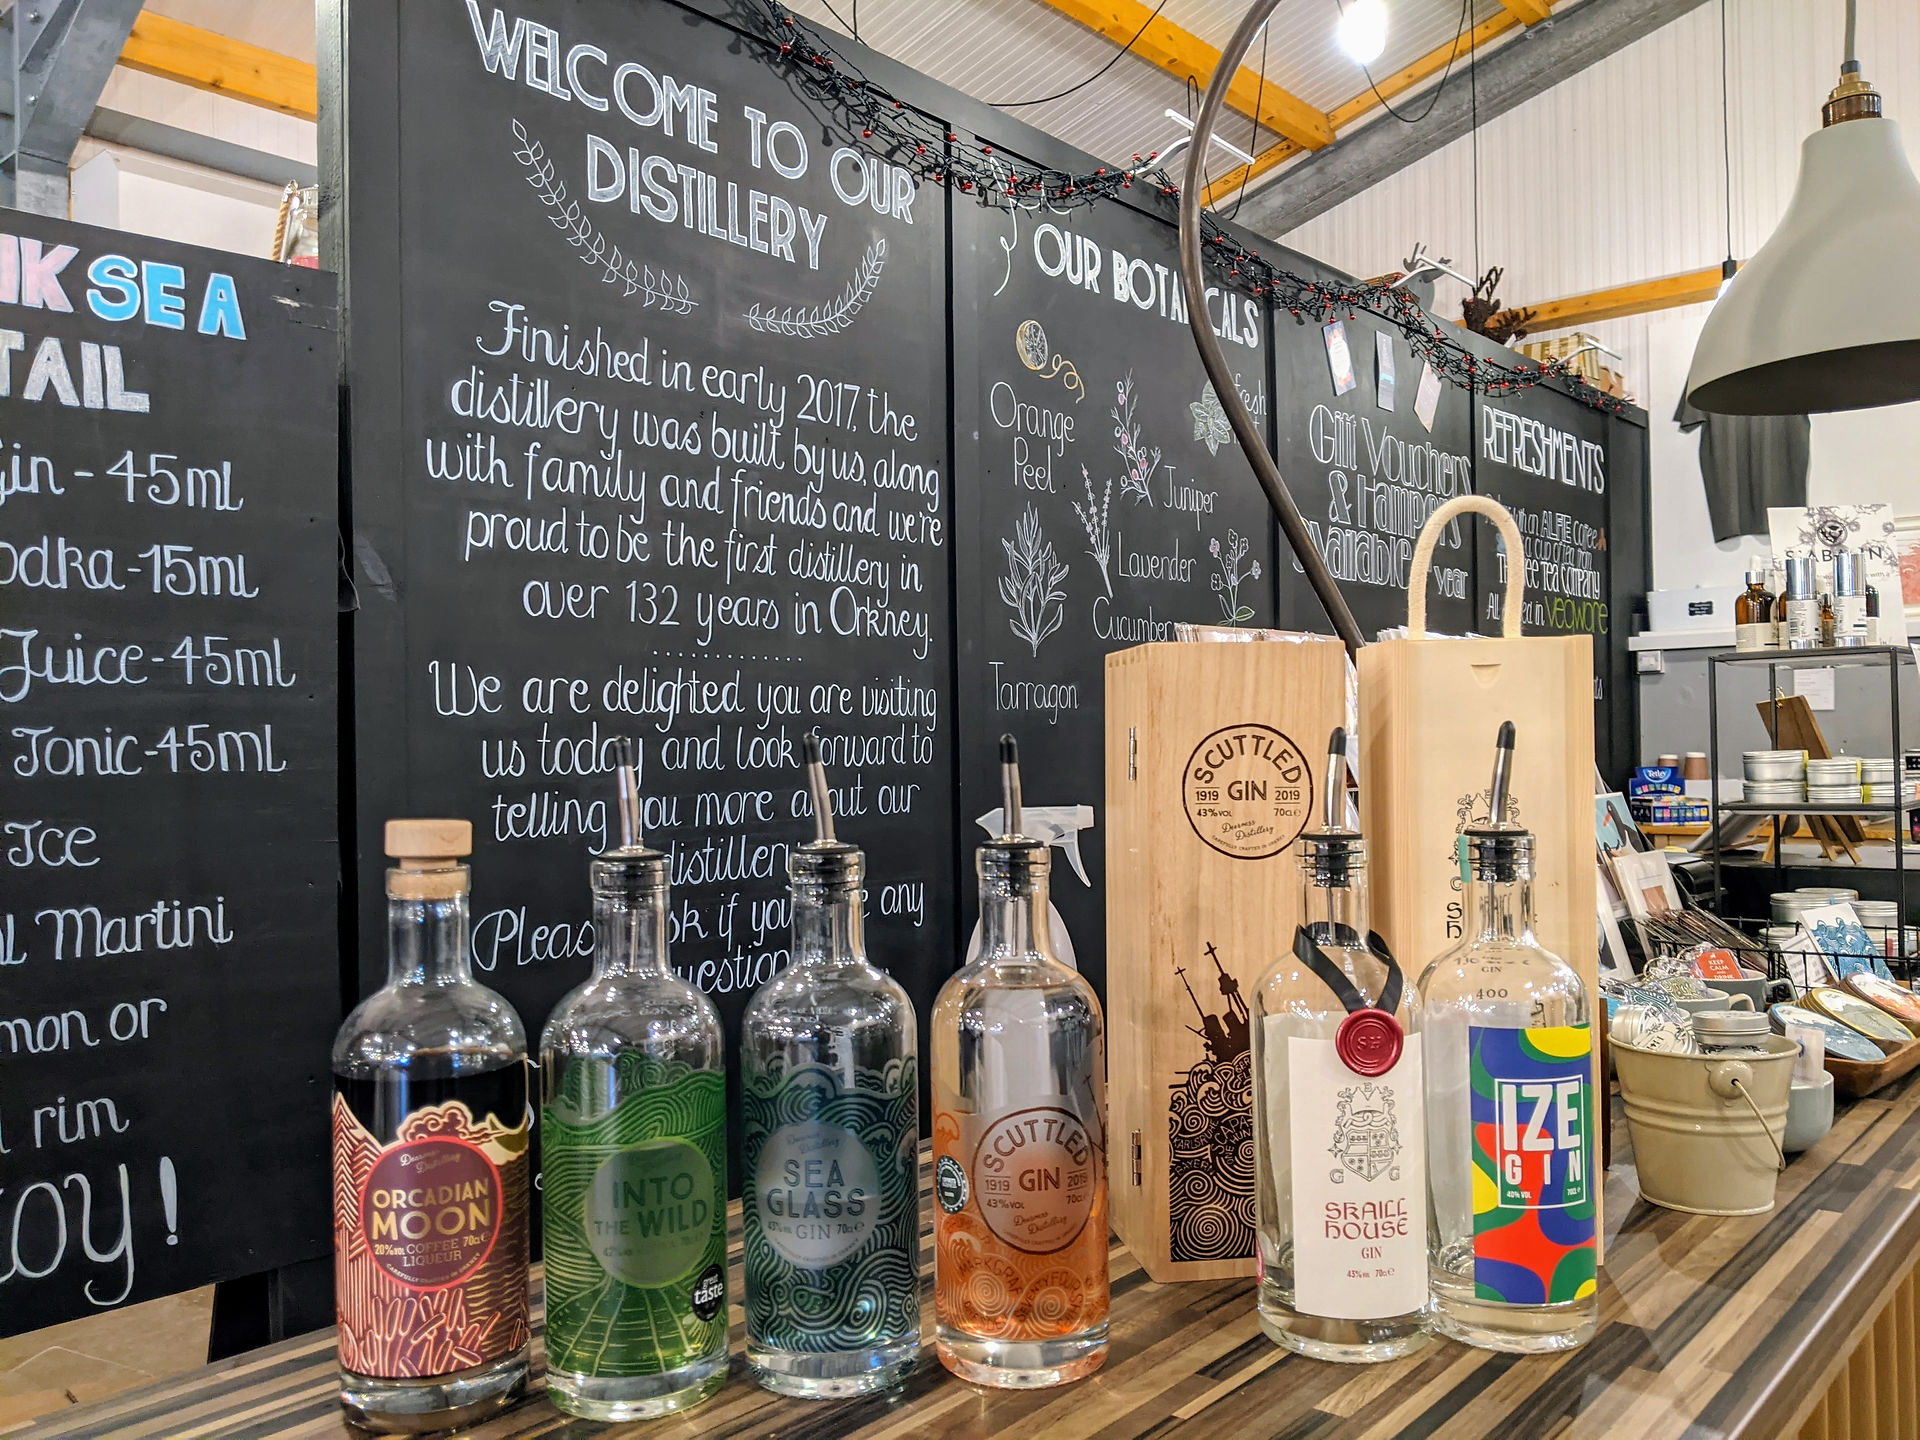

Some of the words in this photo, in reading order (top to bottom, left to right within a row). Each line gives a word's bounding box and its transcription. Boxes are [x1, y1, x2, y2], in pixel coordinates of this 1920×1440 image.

[466, 0, 718, 153] WELCOME
[744, 106, 808, 179] TO
[830, 148, 915, 224] OUR
[587, 134, 828, 270] DISTILLERY
[1034, 223, 1102, 294] OUR
[86, 254, 246, 340] SEA
[476, 300, 652, 386] Finished
[662, 349, 695, 393] in
[702, 366, 786, 429] early
[867, 388, 918, 441] the
[451, 365, 618, 460] distillery
[633, 410, 701, 455] was
[711, 411, 785, 469] built
[793, 427, 826, 493] by
[832, 449, 867, 486] us,
[873, 449, 939, 513] along
[991, 381, 1075, 457] Orange
[1014, 436, 1056, 494] Peel
[1310, 404, 1358, 471] Gift
[1361, 417, 1472, 496] Vouchers
[1483, 404, 1605, 495] REFRESHMENTS
[427, 432, 514, 487] with
[524, 441, 646, 524] family
[660, 466, 724, 514] and
[731, 469, 827, 529] friends
[832, 492, 880, 536] and
[888, 511, 943, 546] we're
[1164, 465, 1218, 531] Juniper
[1329, 470, 1352, 525] &
[465, 507, 568, 562] proud
[576, 510, 609, 559] to
[617, 514, 651, 563] be
[662, 520, 718, 568] the
[724, 528, 777, 585] first
[789, 538, 889, 608] distillery
[900, 554, 923, 592] in
[1118, 531, 1197, 583] Lavender
[1433, 566, 1468, 599] year
[523, 580, 609, 618] over
[626, 580, 680, 626] 132
[697, 592, 779, 646] years
[795, 592, 822, 635] in
[830, 586, 933, 659] Orkney.
[1093, 596, 1174, 642] Cucumber
[429, 661, 502, 716] We
[522, 677, 591, 714] are
[603, 665, 745, 733] delighted
[757, 682, 801, 730] you
[810, 684, 853, 714] are
[863, 675, 936, 731] visiting
[988, 661, 1079, 724] Tarragon
[482, 740, 526, 778] us
[661, 725, 725, 770] and
[737, 725, 800, 769] look
[911, 723, 933, 764] to
[1194, 734, 1302, 784] SCUTTLED
[492, 791, 607, 855] telling
[695, 791, 774, 827] more
[791, 773, 868, 818] aout
[878, 784, 920, 815] our
[1196, 790, 1219, 801] 1919
[1227, 780, 1267, 801] GIN
[1275, 790, 1300, 801] 2019
[1235, 826, 1274, 841] Distillery
[35, 896, 234, 960] Martini
[472, 905, 595, 971] Pleas
[669, 899, 708, 943] sk
[719, 893, 740, 951] if
[881, 881, 924, 926] any
[109, 998, 167, 1041] or
[34, 1096, 129, 1148] rim
[1173, 1119, 1219, 1150] KARLSRUHE
[1502, 1081, 1580, 1152] IZE
[983, 1118, 1089, 1173] SCUTTLED
[373, 1178, 488, 1209] ORCADIAN
[612, 1172, 694, 1209] INTO
[783, 1159, 845, 1188] SEA
[985, 1179, 1010, 1191] 1919
[1019, 1167, 1060, 1192] GIN
[372, 1199, 490, 1241] MOON
[594, 1220, 630, 1236] THE
[638, 1199, 707, 1238] WILD
[767, 1188, 866, 1219] GLASS
[1325, 1198, 1408, 1221] SKAILL
[403, 1250, 462, 1267] LIQUEUR
[406, 1238, 459, 1255] COFFEE
[796, 1224, 831, 1240] GIN
[1361, 1246, 1382, 1259] GIN
[694, 1283, 724, 1305] taste
